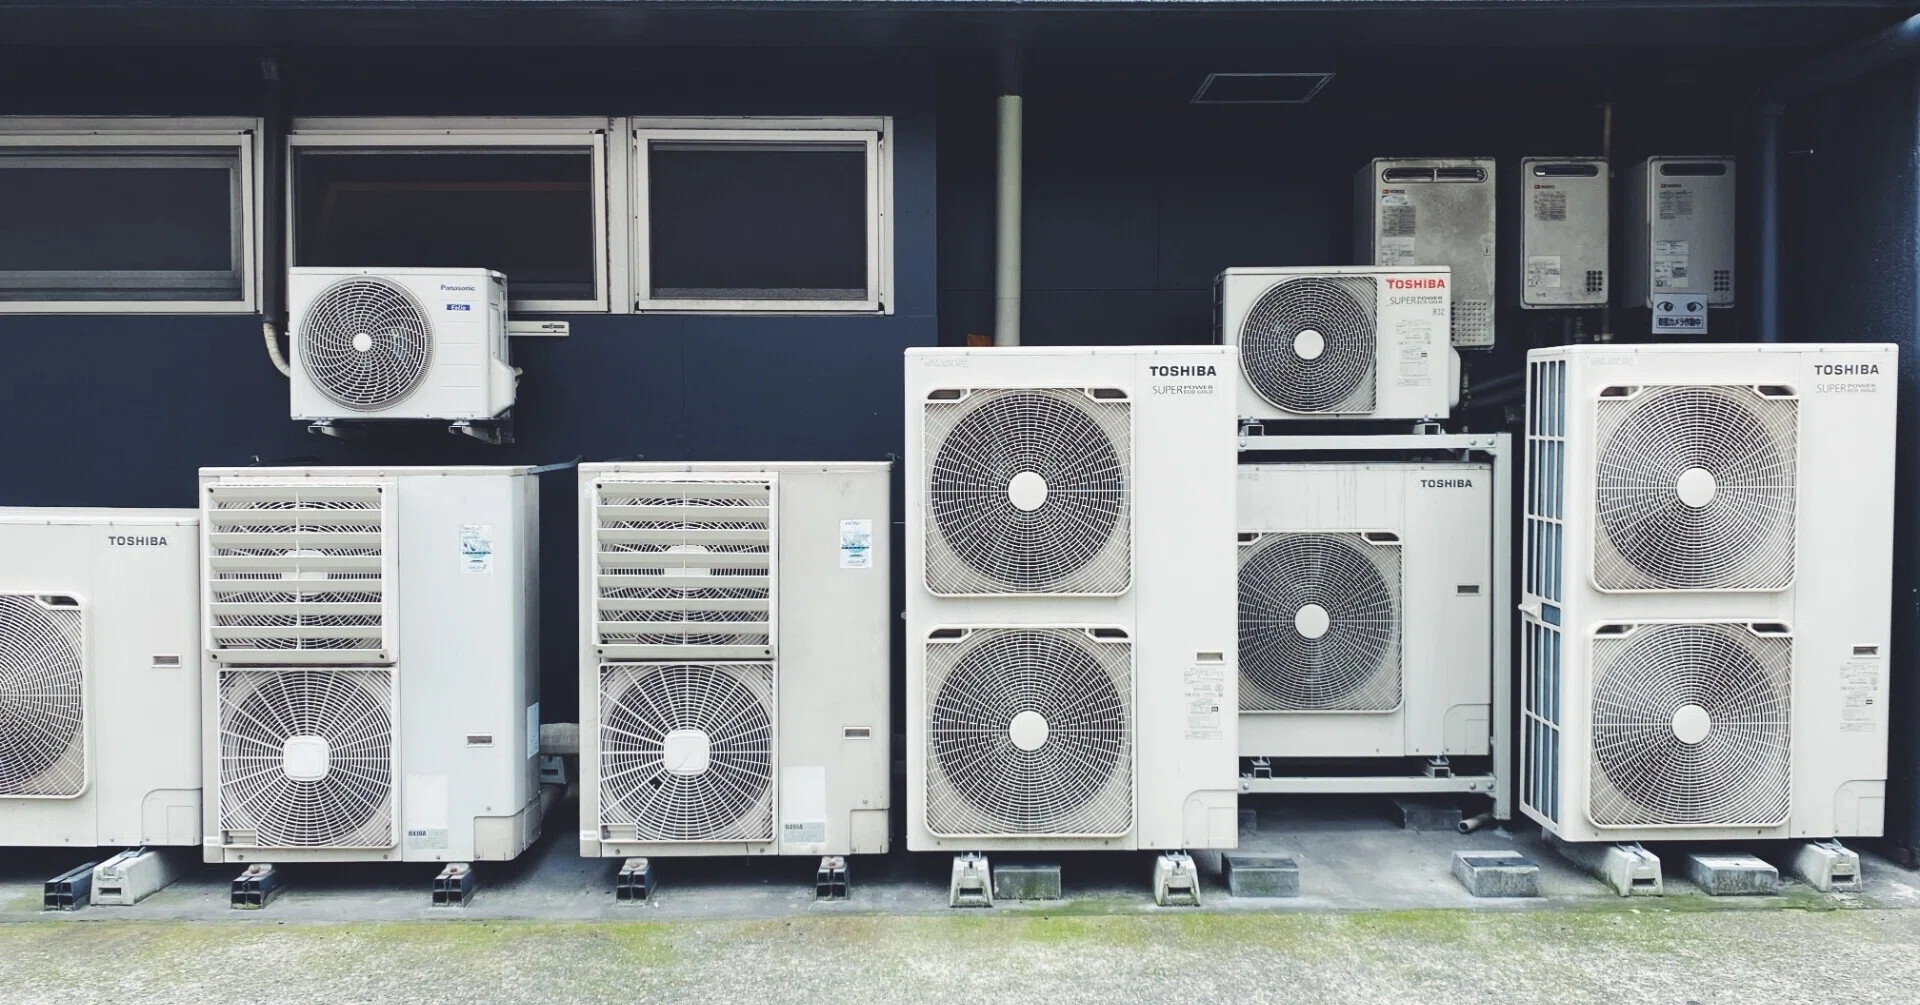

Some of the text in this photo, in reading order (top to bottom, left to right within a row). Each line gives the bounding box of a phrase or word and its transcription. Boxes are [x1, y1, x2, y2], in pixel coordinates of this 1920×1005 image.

[1385, 279, 1445, 289] TOSHIBA
[1390, 296, 1416, 305] SUPER
[1432, 308, 1445, 316] R32
[1149, 365, 1217, 377] TOSHIBA
[1814, 364, 1879, 375] TOSHIBA
[1152, 385, 1183, 395] SUPER
[1817, 384, 1847, 393] SUPER
[1420, 479, 1473, 488] TOSHIBA
[108, 536, 168, 546] TOSHIBA
